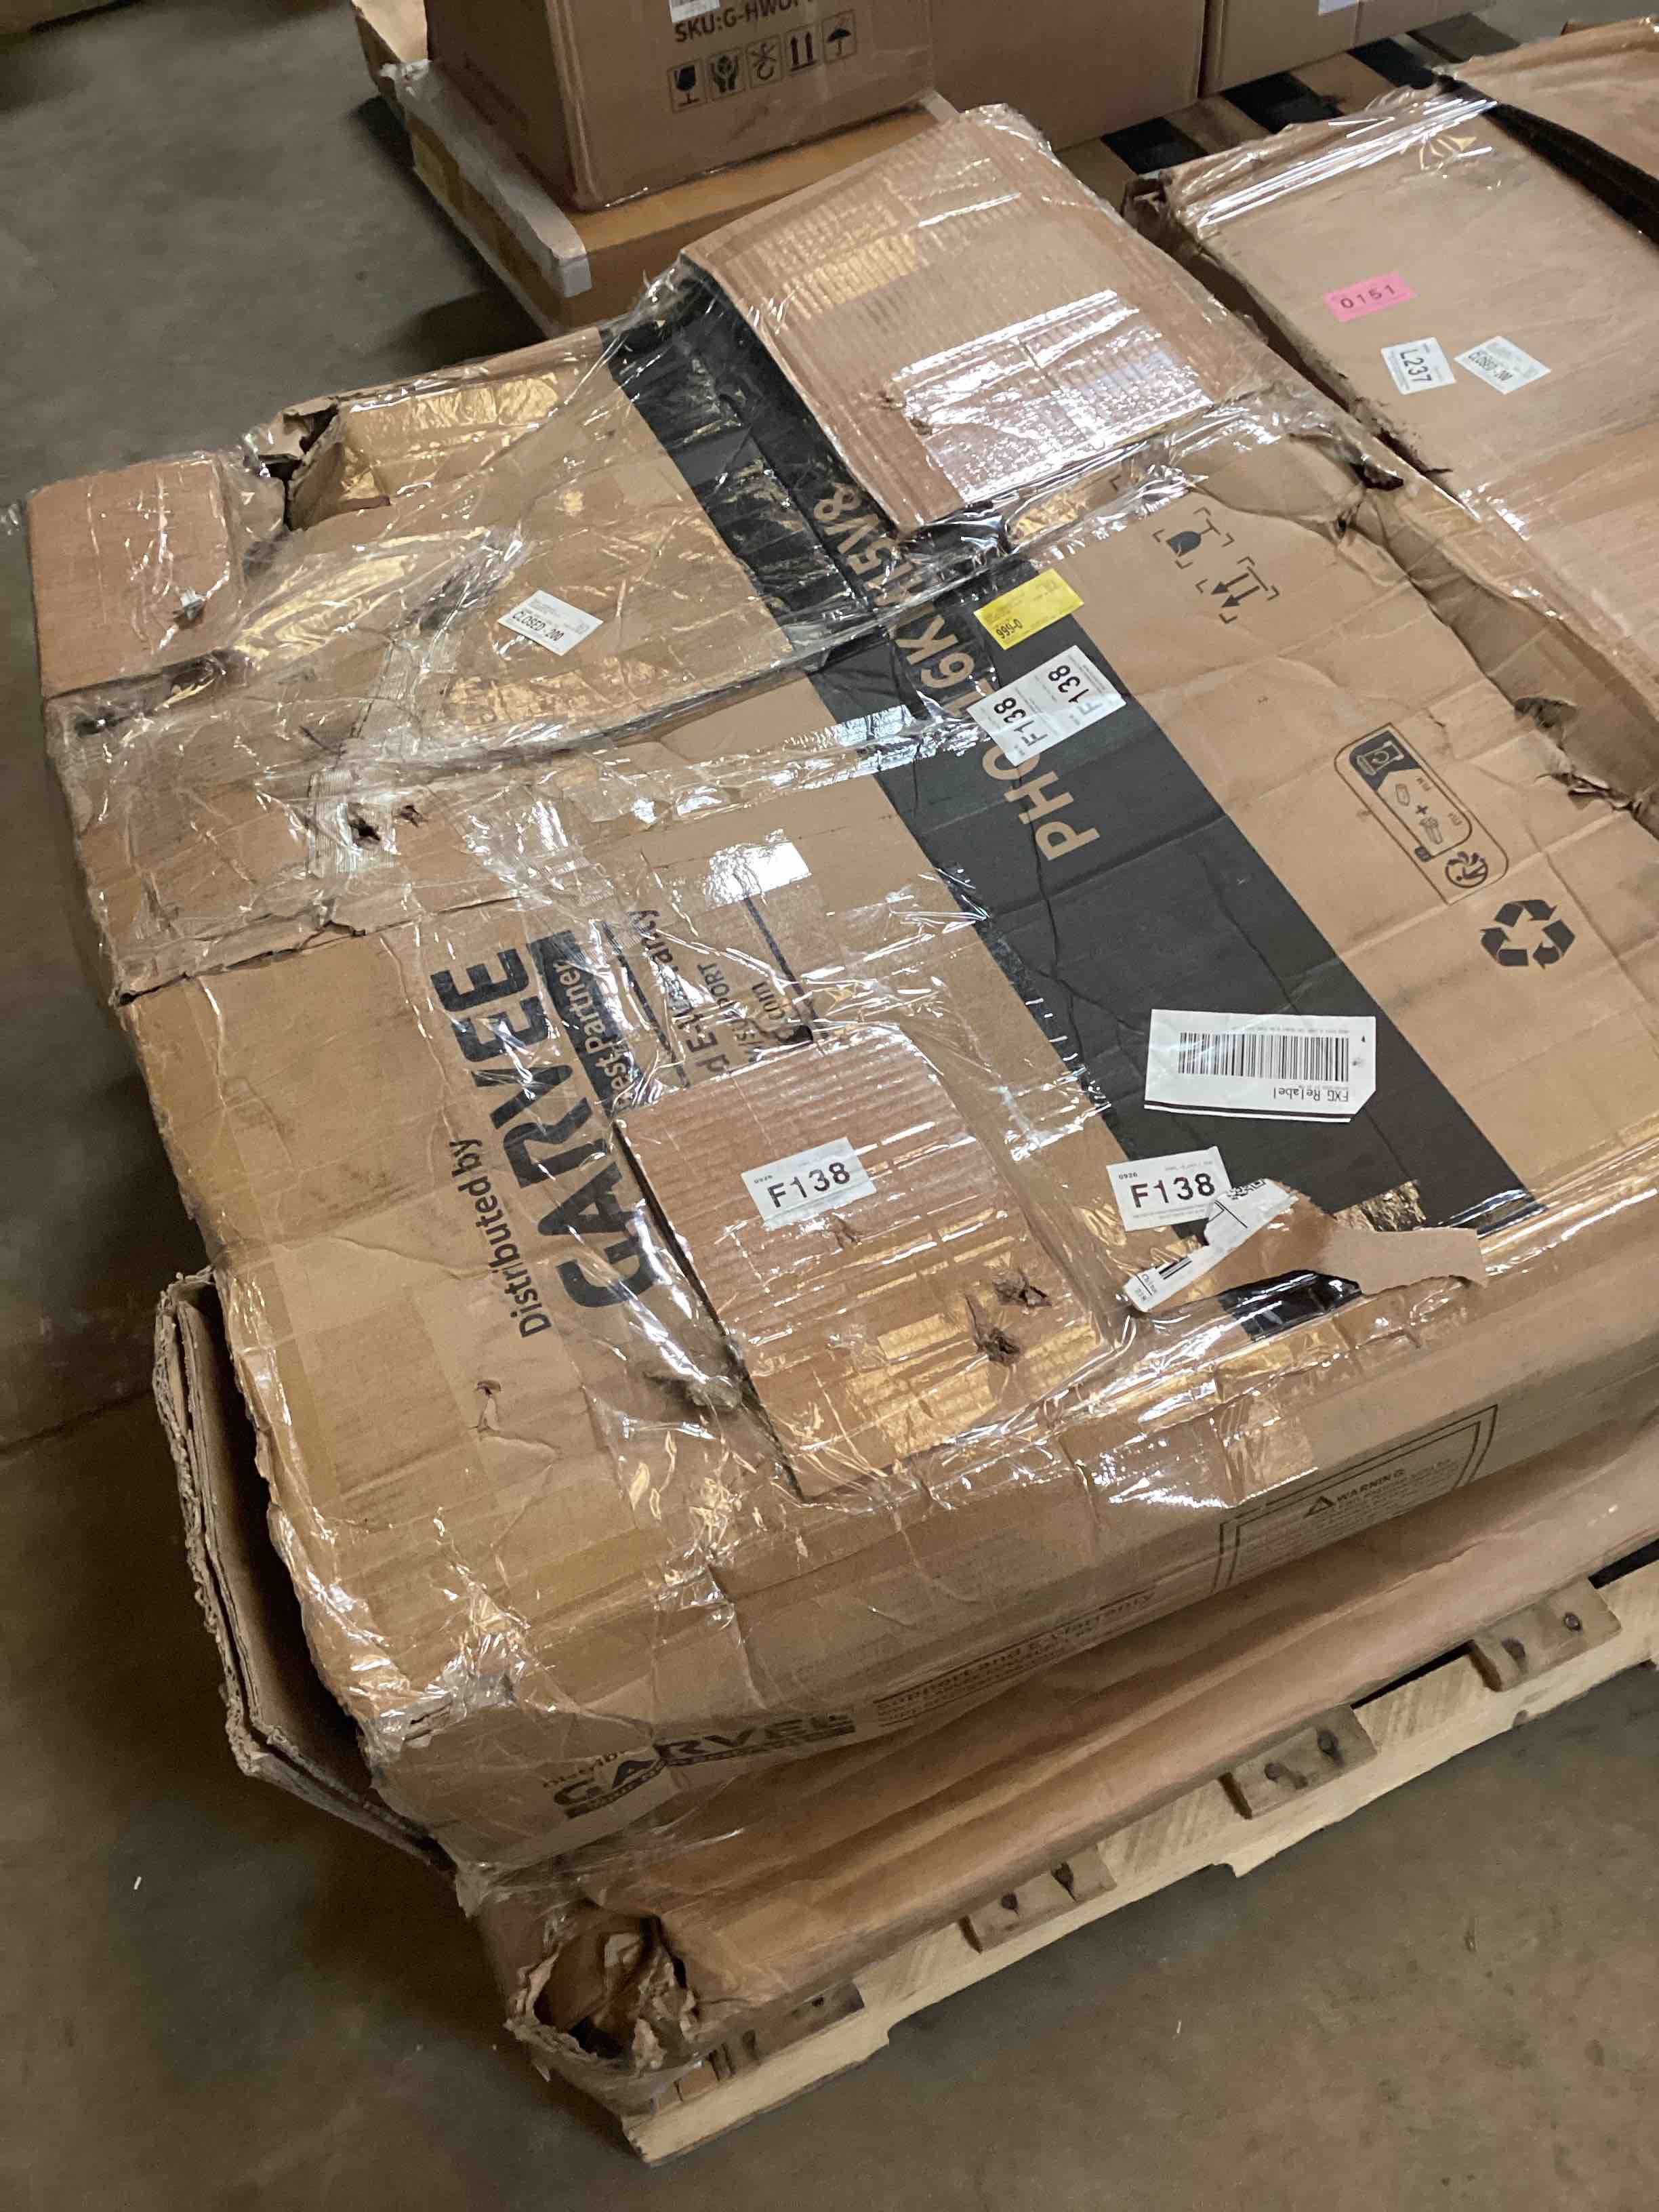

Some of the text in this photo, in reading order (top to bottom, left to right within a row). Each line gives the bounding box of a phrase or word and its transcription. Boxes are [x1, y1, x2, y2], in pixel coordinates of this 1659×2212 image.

[1340, 284, 1397, 309] 0151
[1399, 348, 1433, 384] L237
[1048, 665, 1103, 716] F138
[994, 697, 1048, 746] F138
[553, 960, 607, 1055] Partner
[1273, 1087, 1349, 1102] FXG Relabel
[430, 947, 655, 1308] GARVEE
[766, 1162, 851, 1208] F138
[1130, 1172, 1215, 1208] F138
[449, 1139, 552, 1338] Distributed by
[1337, 1469, 1405, 1502] WARNING
